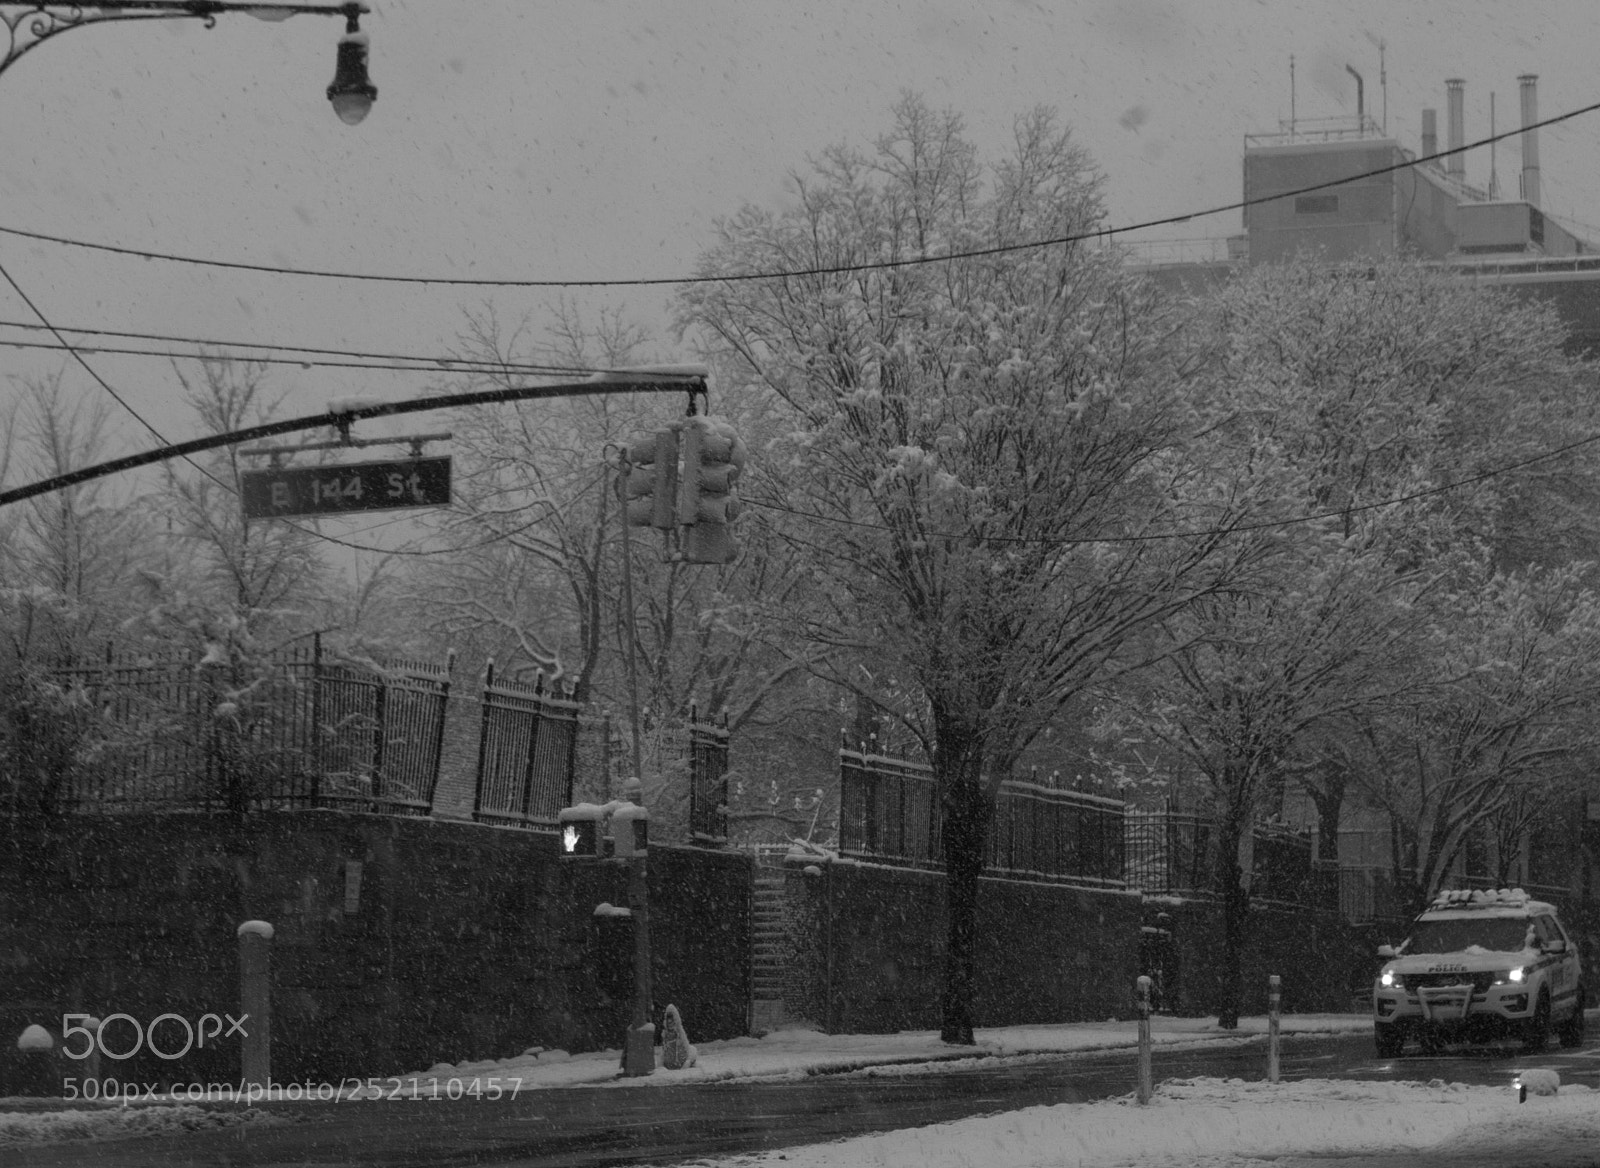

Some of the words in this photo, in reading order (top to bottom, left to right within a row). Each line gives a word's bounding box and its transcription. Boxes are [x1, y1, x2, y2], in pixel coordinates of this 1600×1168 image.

[271, 482, 289, 507] E
[310, 476, 363, 506] 144
[386, 472, 425, 503] St
